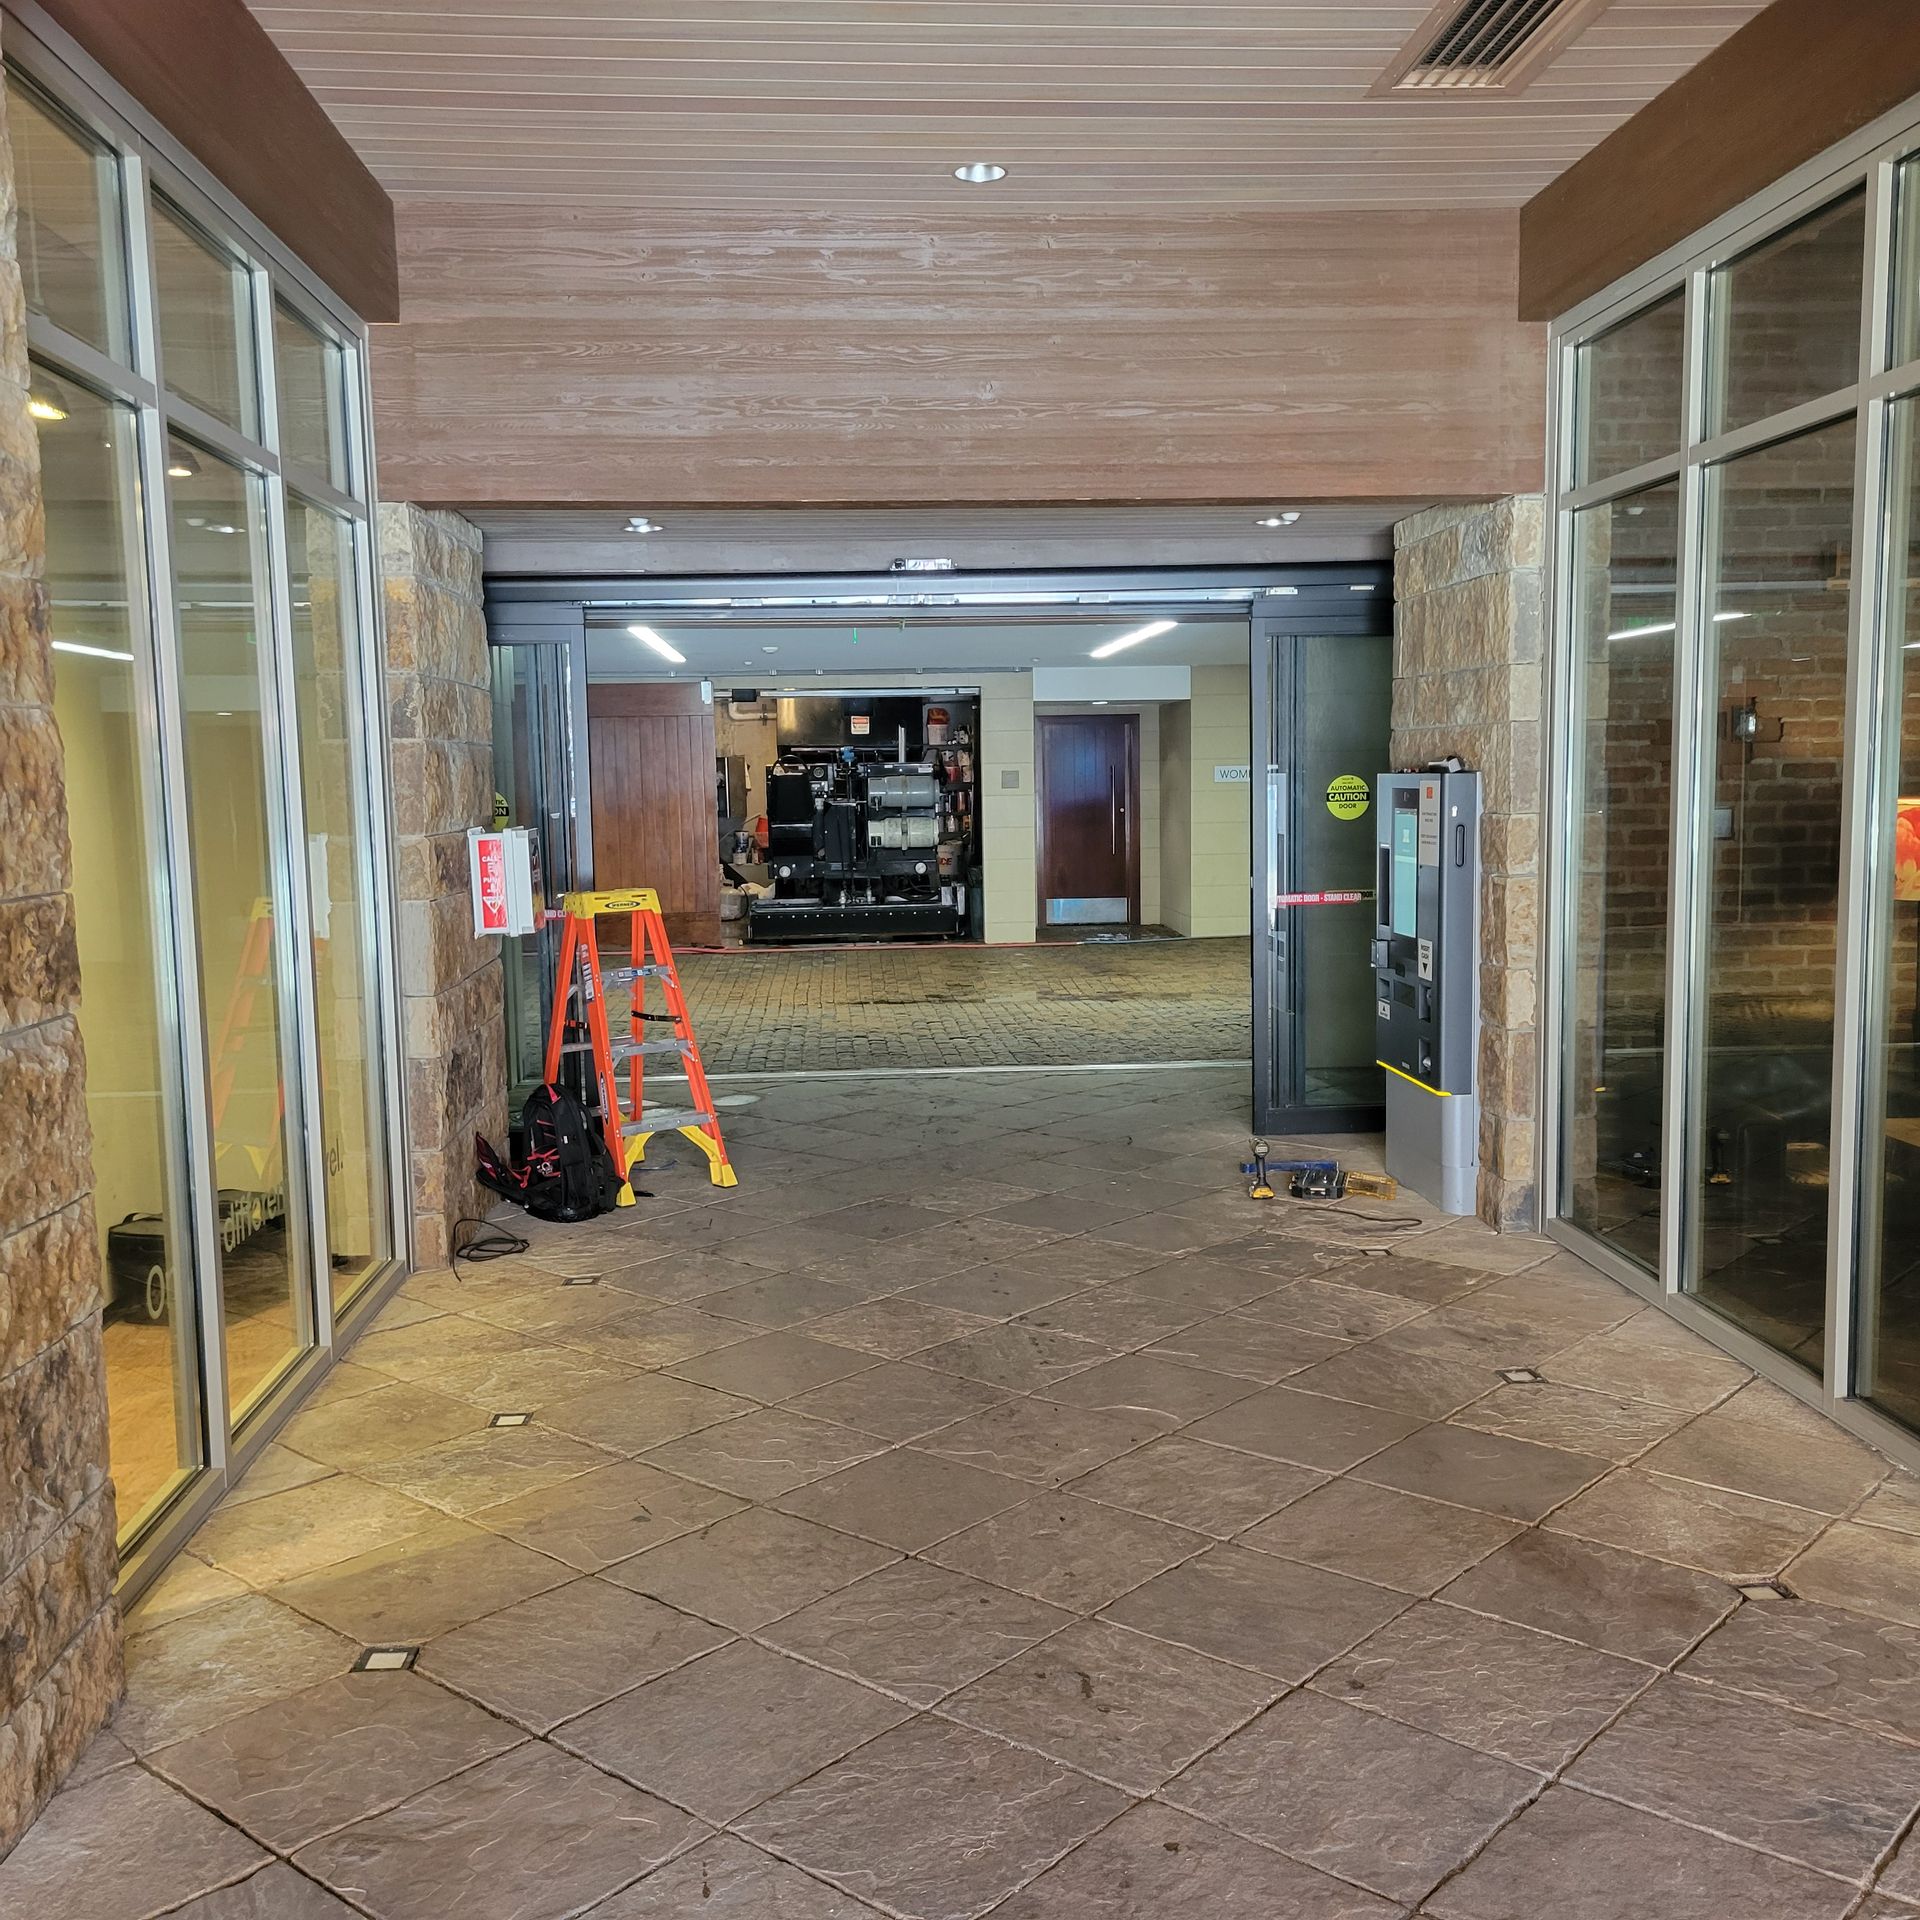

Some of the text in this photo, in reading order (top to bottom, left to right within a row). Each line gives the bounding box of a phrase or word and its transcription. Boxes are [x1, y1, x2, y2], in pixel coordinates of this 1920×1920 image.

[1219, 769, 1250, 779] WOM
[1328, 792, 1367, 801] CAUTION
[1277, 894, 1303, 903] TOMATIC
[1303, 894, 1320, 903] DOOR
[1323, 893, 1342, 902] STAND
[1343, 892, 1361, 901] CLEAR
[544, 909, 557, 918] AND
